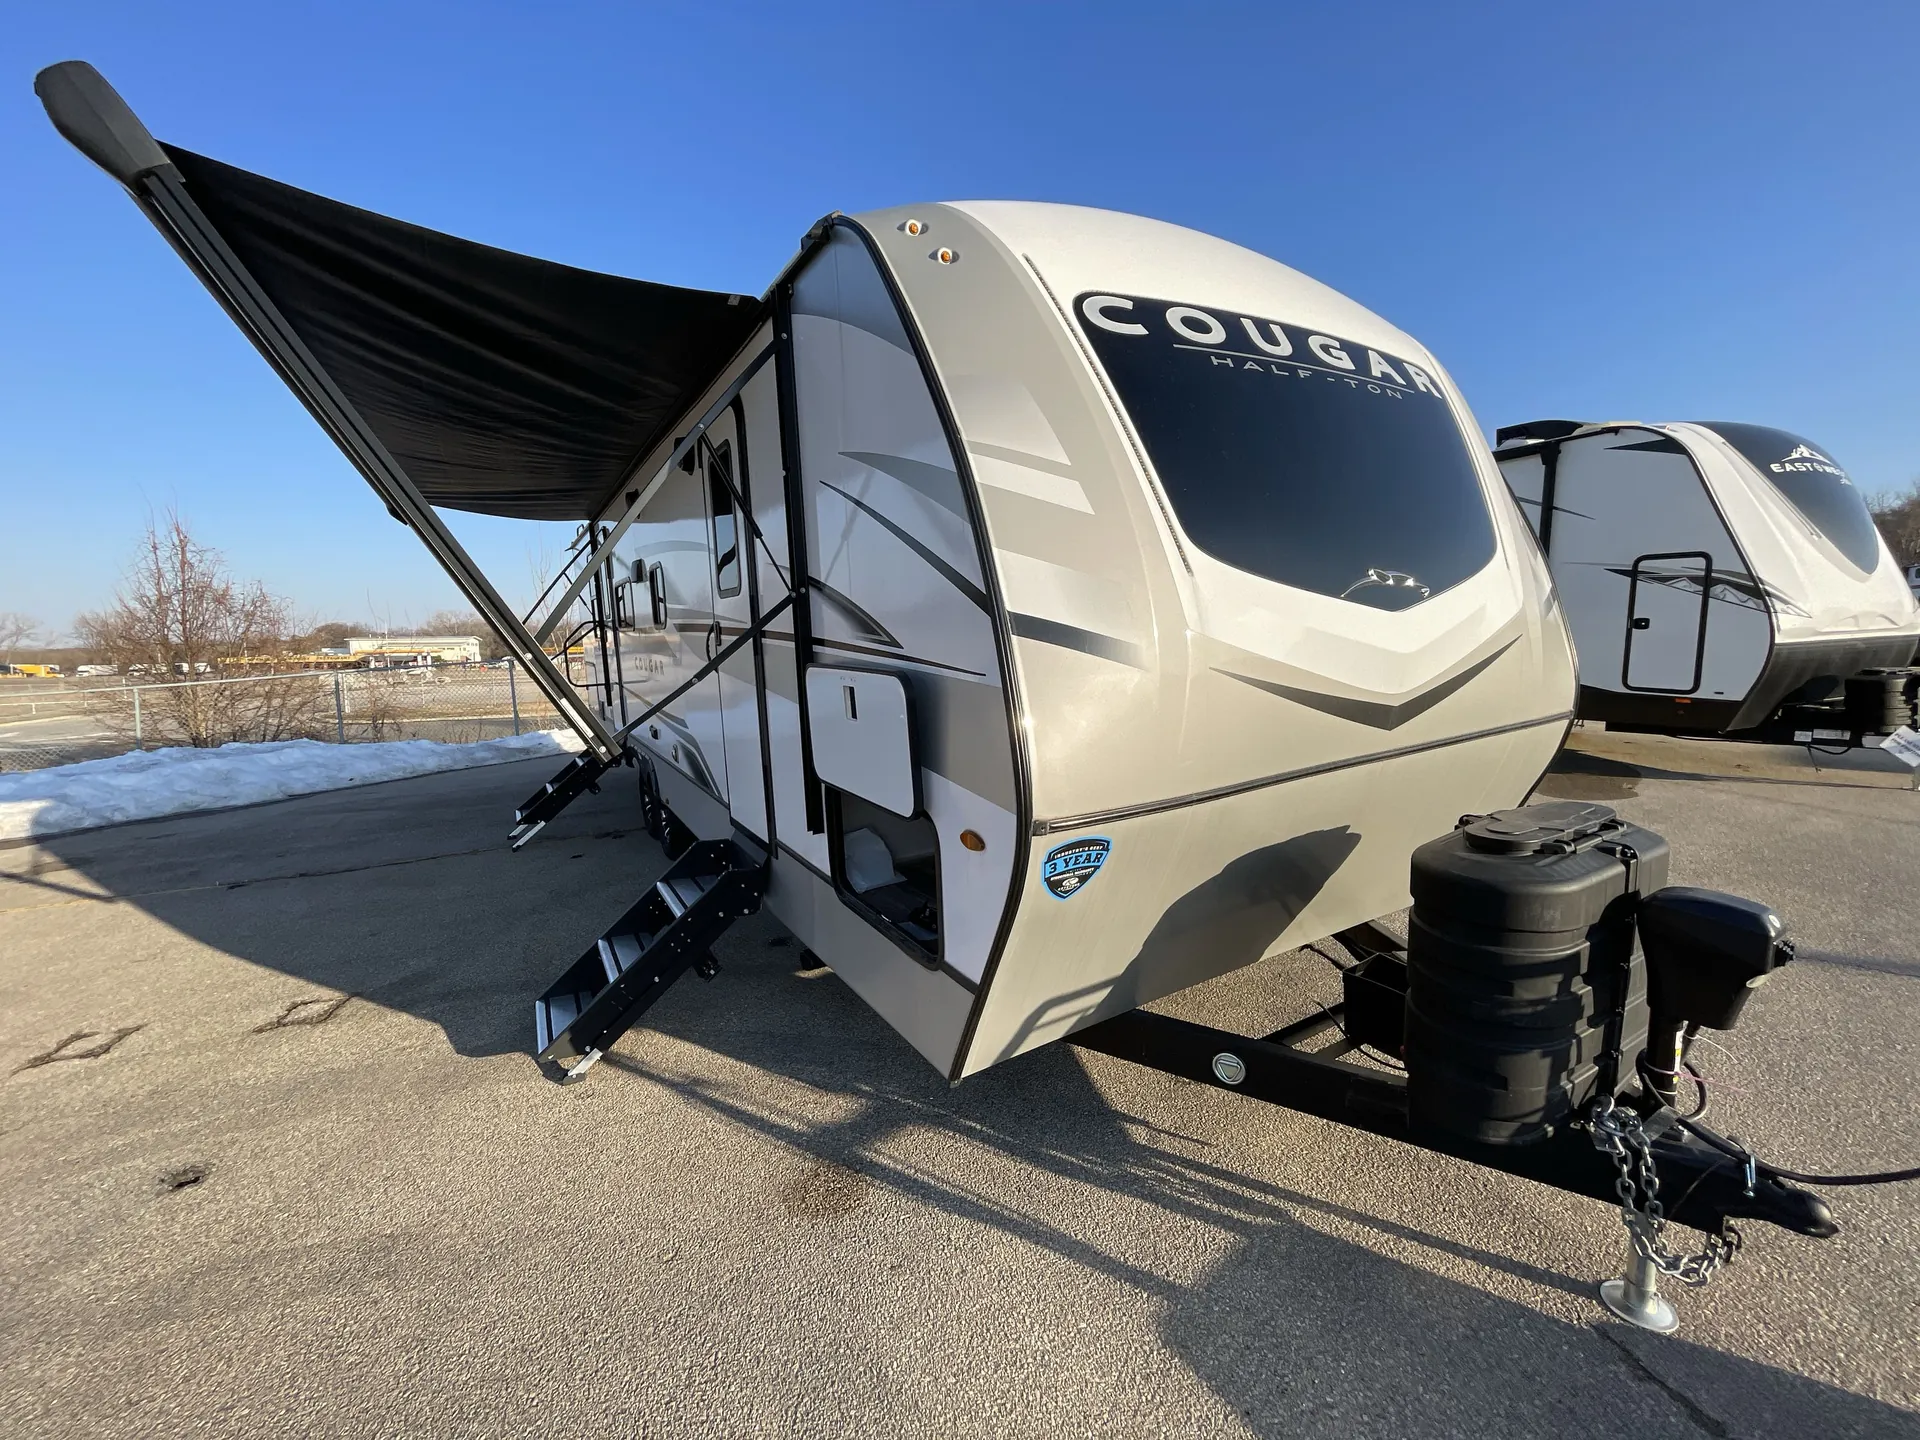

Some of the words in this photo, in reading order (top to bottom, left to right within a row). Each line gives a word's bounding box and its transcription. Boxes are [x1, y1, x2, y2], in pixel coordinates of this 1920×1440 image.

[1082, 295, 1443, 399] COUGAR
[1210, 355, 1404, 400] HALF-TON
[1769, 462, 1813, 473] EAST
[634, 656, 665, 676] COUGAR
[1048, 862, 1058, 875] 3
[1063, 852, 1104, 869] YEAR
